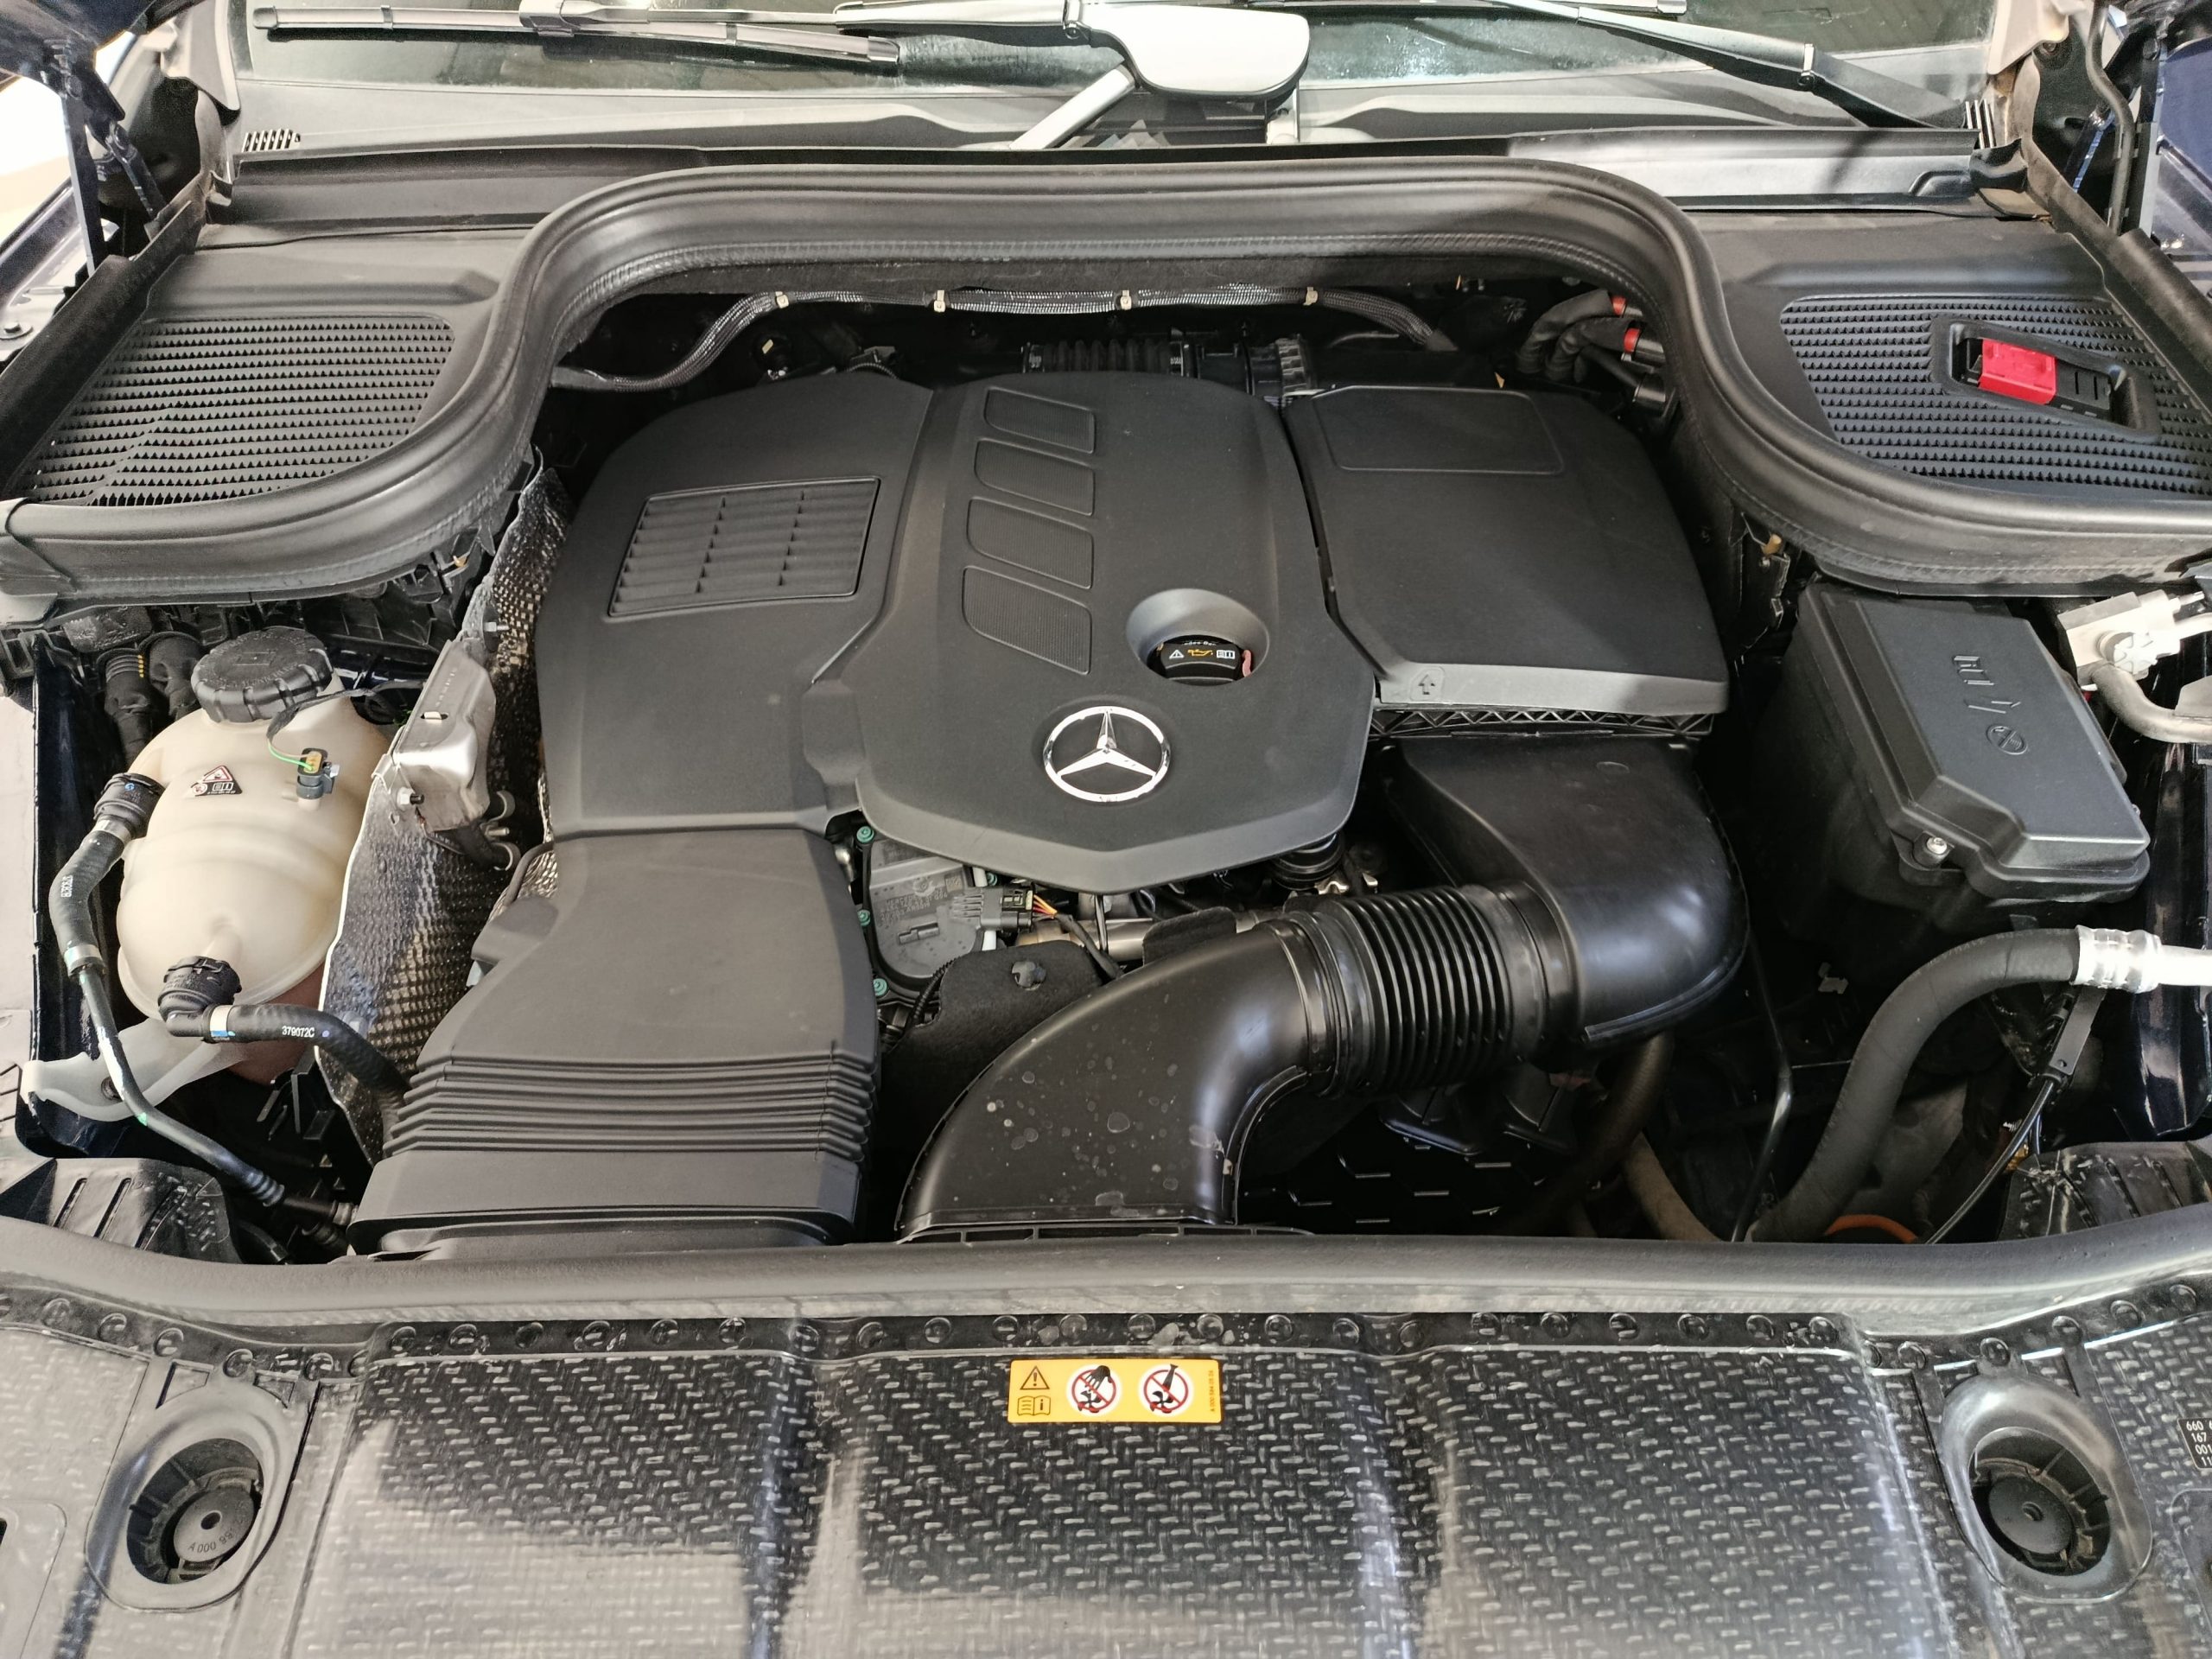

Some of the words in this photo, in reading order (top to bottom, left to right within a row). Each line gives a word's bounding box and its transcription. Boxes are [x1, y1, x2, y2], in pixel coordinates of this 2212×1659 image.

[282, 1025, 315, 1038] 379072C
[2186, 1421, 2203, 1431] 660
[2191, 1432, 2207, 1442] 167
[2195, 1444, 2212, 1454] 001
[197, 1541, 217, 1553] 000
